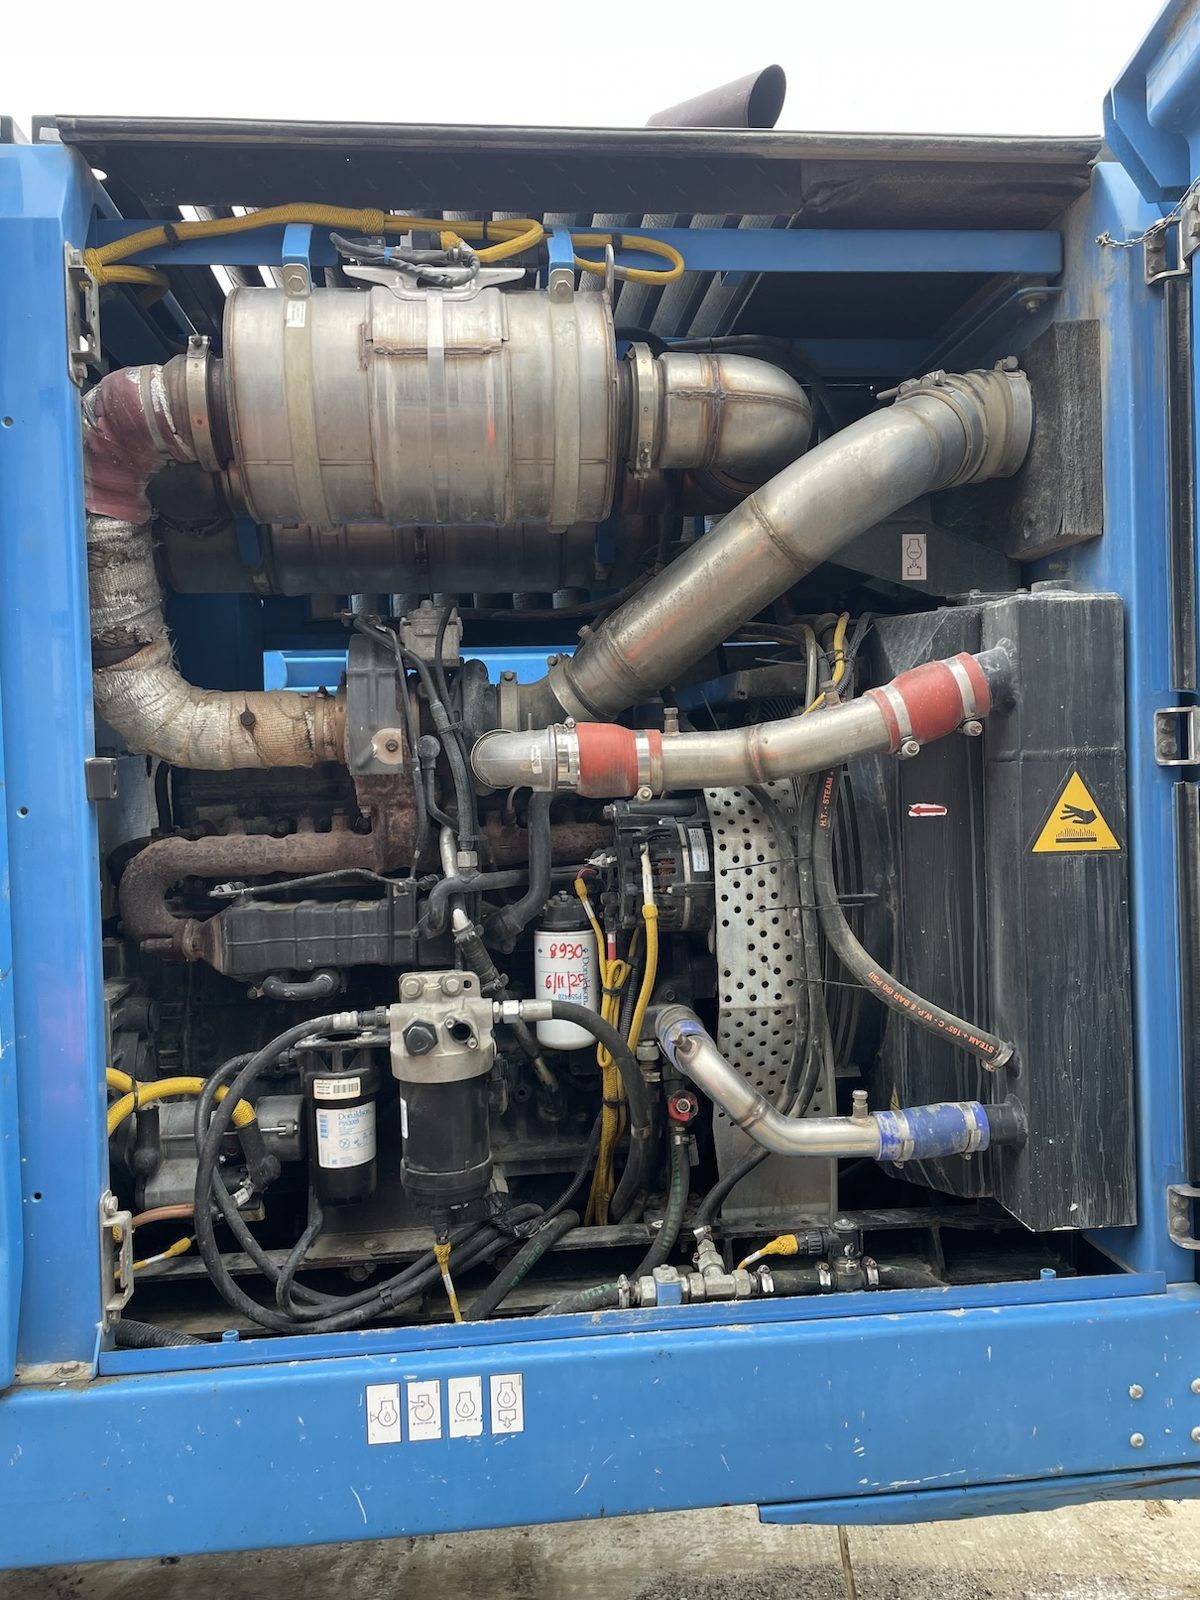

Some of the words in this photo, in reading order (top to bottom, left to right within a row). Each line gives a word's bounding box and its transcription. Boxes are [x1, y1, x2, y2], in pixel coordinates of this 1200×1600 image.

[823, 777, 833, 805] STEAM
[820, 811, 828, 827] H.T.
[550, 943, 583, 960] 8930
[893, 992, 911, 1007] BAR
[910, 1003, 917, 1011] 6
[969, 1035, 995, 1053] STEAM
